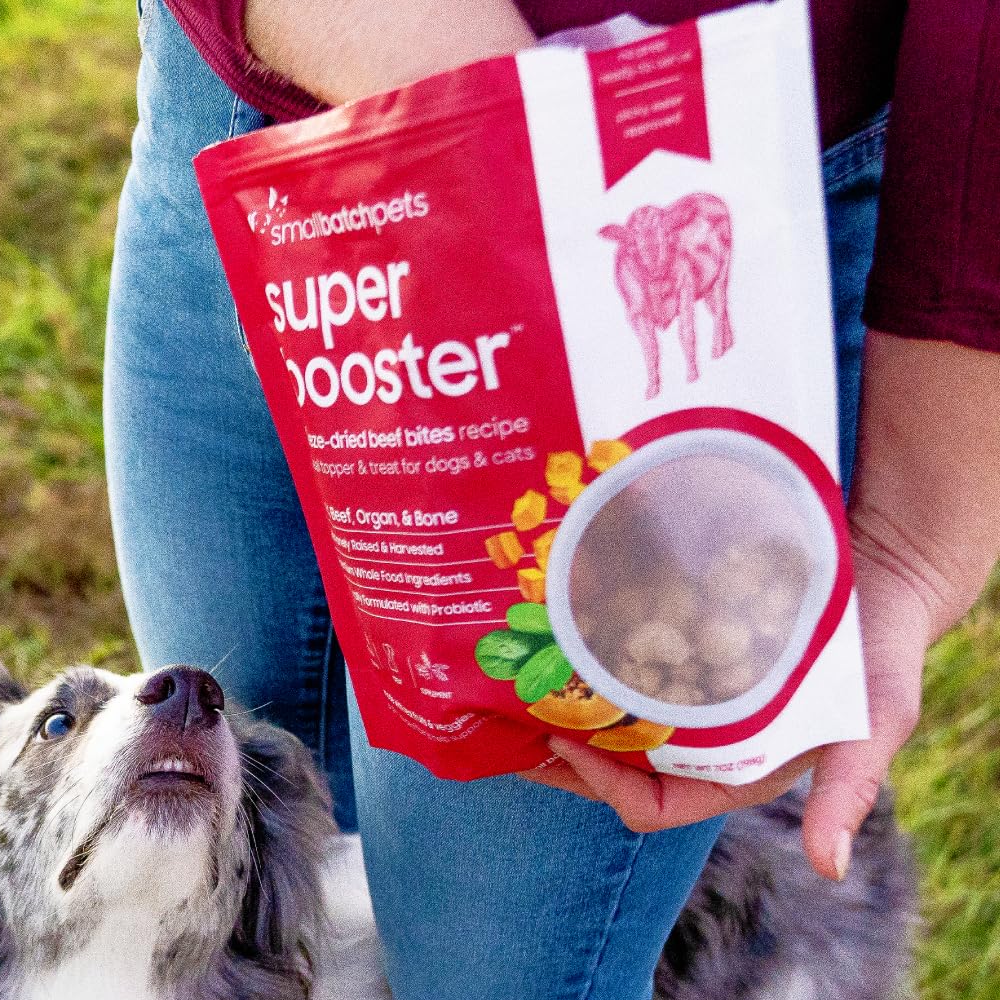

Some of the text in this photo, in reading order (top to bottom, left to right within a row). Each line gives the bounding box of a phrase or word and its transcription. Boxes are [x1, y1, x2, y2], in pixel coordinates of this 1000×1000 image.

[271, 190, 430, 246] smallbatchpets
[265, 261, 411, 349] super
[369, 426, 402, 448] beef
[404, 424, 455, 447] bites
[458, 416, 531, 440] recipe
[357, 459, 367, 475] &
[369, 460, 400, 475] treat
[400, 458, 421, 475] for
[424, 456, 471, 475] dogs
[473, 451, 488, 468] &
[491, 446, 537, 465] cats
[401, 510, 412, 526] &
[413, 510, 459, 527] Bone
[389, 542, 445, 556] Harvested
